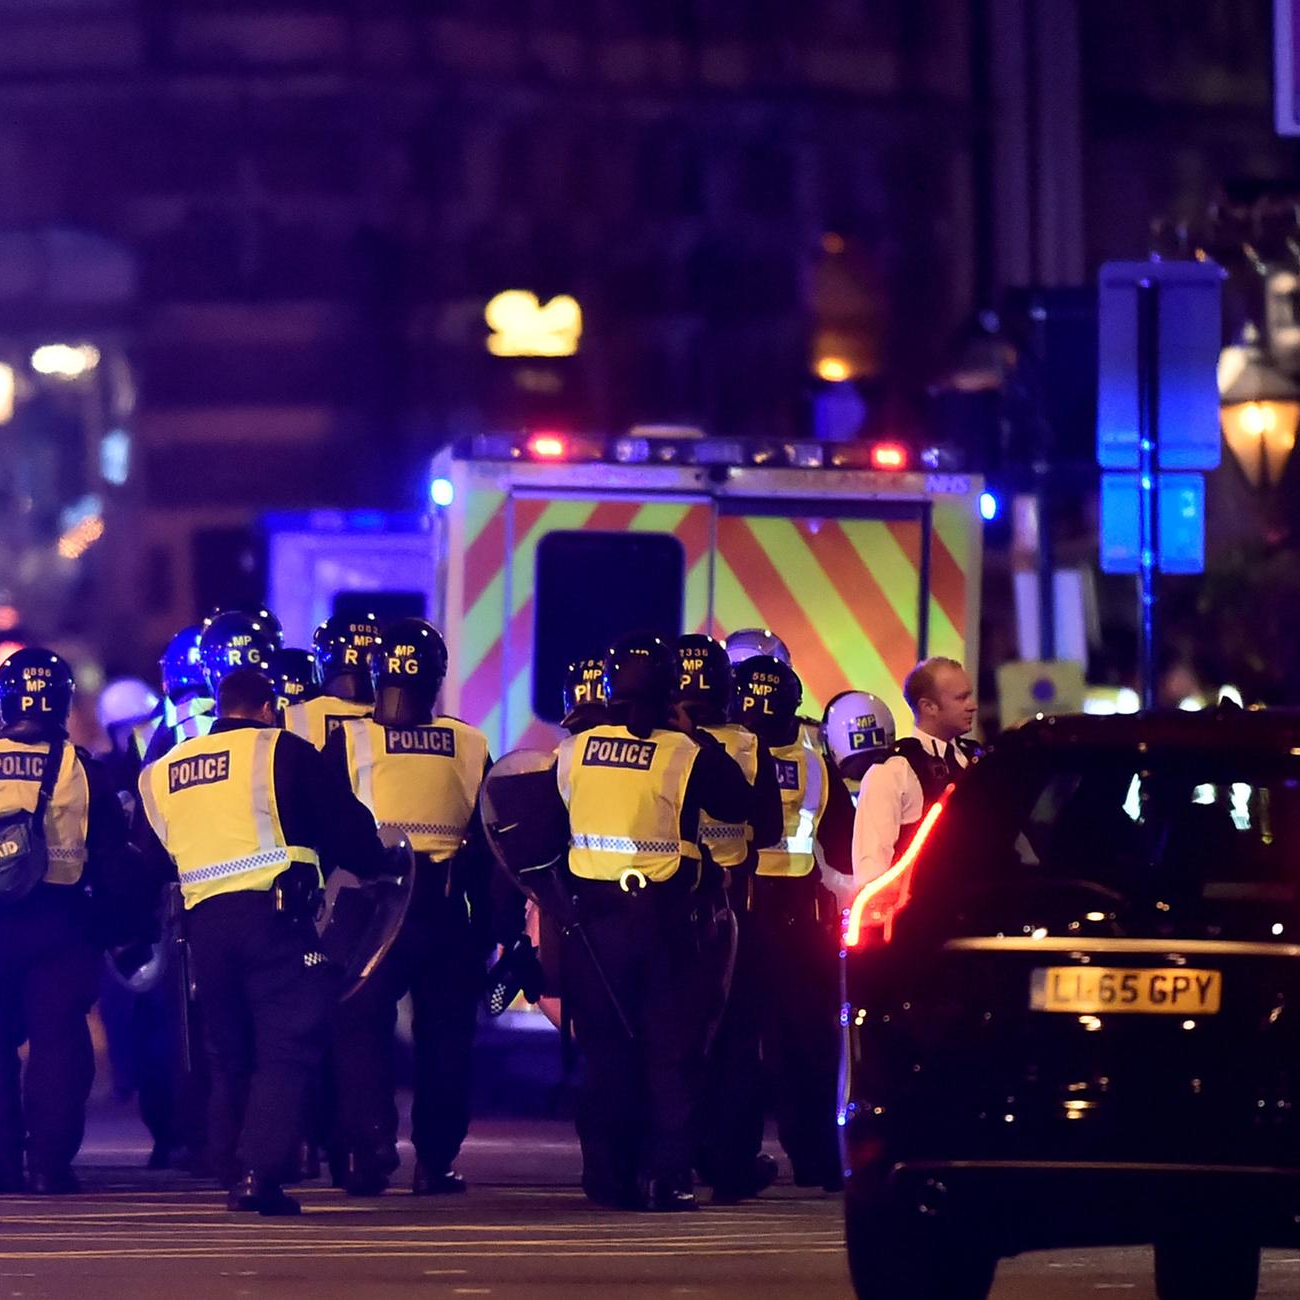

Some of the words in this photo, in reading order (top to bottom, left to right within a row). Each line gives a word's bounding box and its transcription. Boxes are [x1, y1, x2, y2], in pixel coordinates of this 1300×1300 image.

[232, 635, 252, 647] MP
[353, 635, 373, 646] MP
[394, 645, 416, 658] MP
[683, 659, 703, 671] MP
[583, 669, 602, 680] MP
[26, 680, 46, 692] MP
[284, 682, 305, 695] MP
[752, 684, 773, 696] MP
[857, 715, 875, 729] MP
[388, 730, 452, 751] POLICE
[586, 740, 651, 765] POLICE
[170, 756, 226, 788] POLICE
[1149, 975, 1212, 1005] GPY
